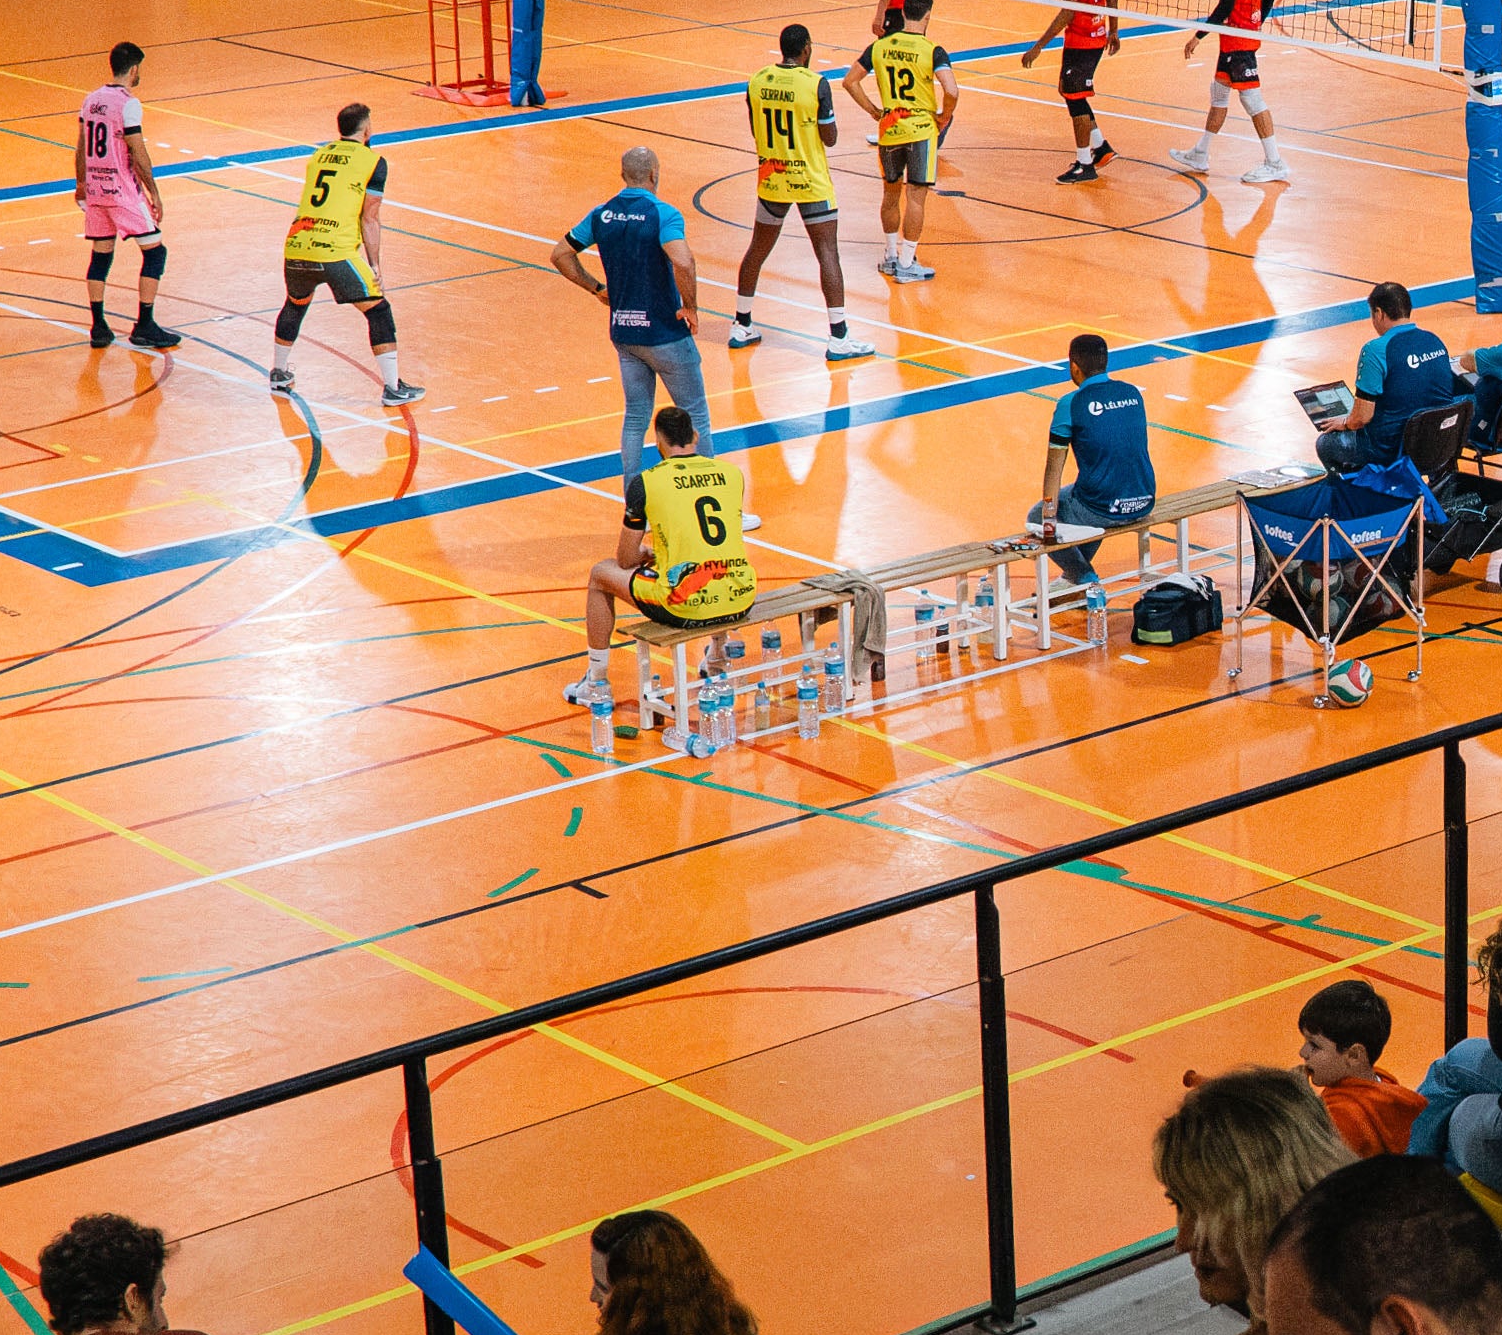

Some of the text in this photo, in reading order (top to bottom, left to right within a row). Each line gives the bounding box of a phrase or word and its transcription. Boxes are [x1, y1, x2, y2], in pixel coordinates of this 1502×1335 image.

[760, 88, 795, 103] SERRANO
[885, 66, 916, 102] 12
[86, 120, 107, 159] 18
[762, 107, 795, 150] 14
[310, 169, 338, 208] 5
[672, 472, 727, 490] SCARPIN
[694, 495, 727, 547] 6
